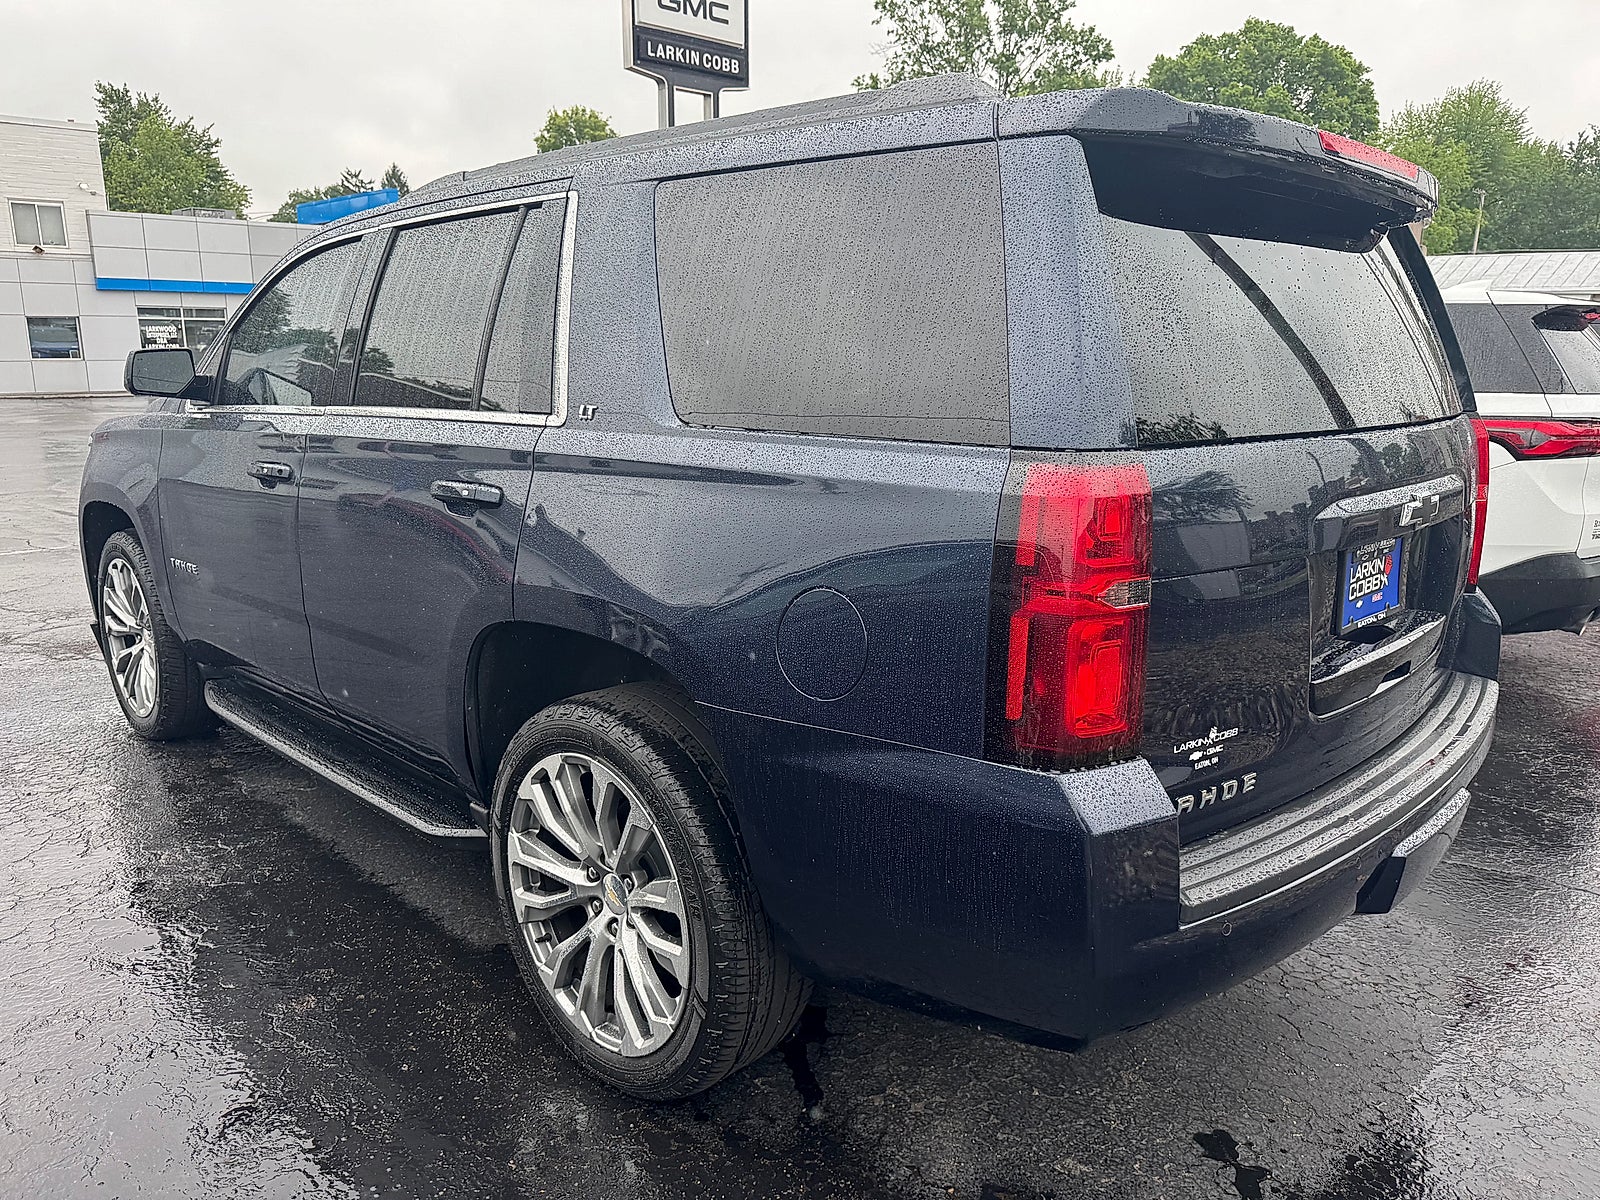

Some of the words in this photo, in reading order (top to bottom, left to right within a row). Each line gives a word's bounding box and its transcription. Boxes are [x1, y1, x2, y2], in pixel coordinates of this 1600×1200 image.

[657, 0, 729, 25] GMC
[647, 41, 700, 66] LARKIN
[703, 53, 740, 74] COBB
[579, 404, 598, 420] LT
[170, 557, 199, 575] TAHOE
[1349, 556, 1386, 584] LARKIN
[1348, 573, 1381, 601] COBB
[1173, 736, 1208, 754] LARKIN
[1213, 727, 1239, 742] COBB
[1206, 744, 1224, 756] GMC
[1175, 772, 1257, 815] AHOE
